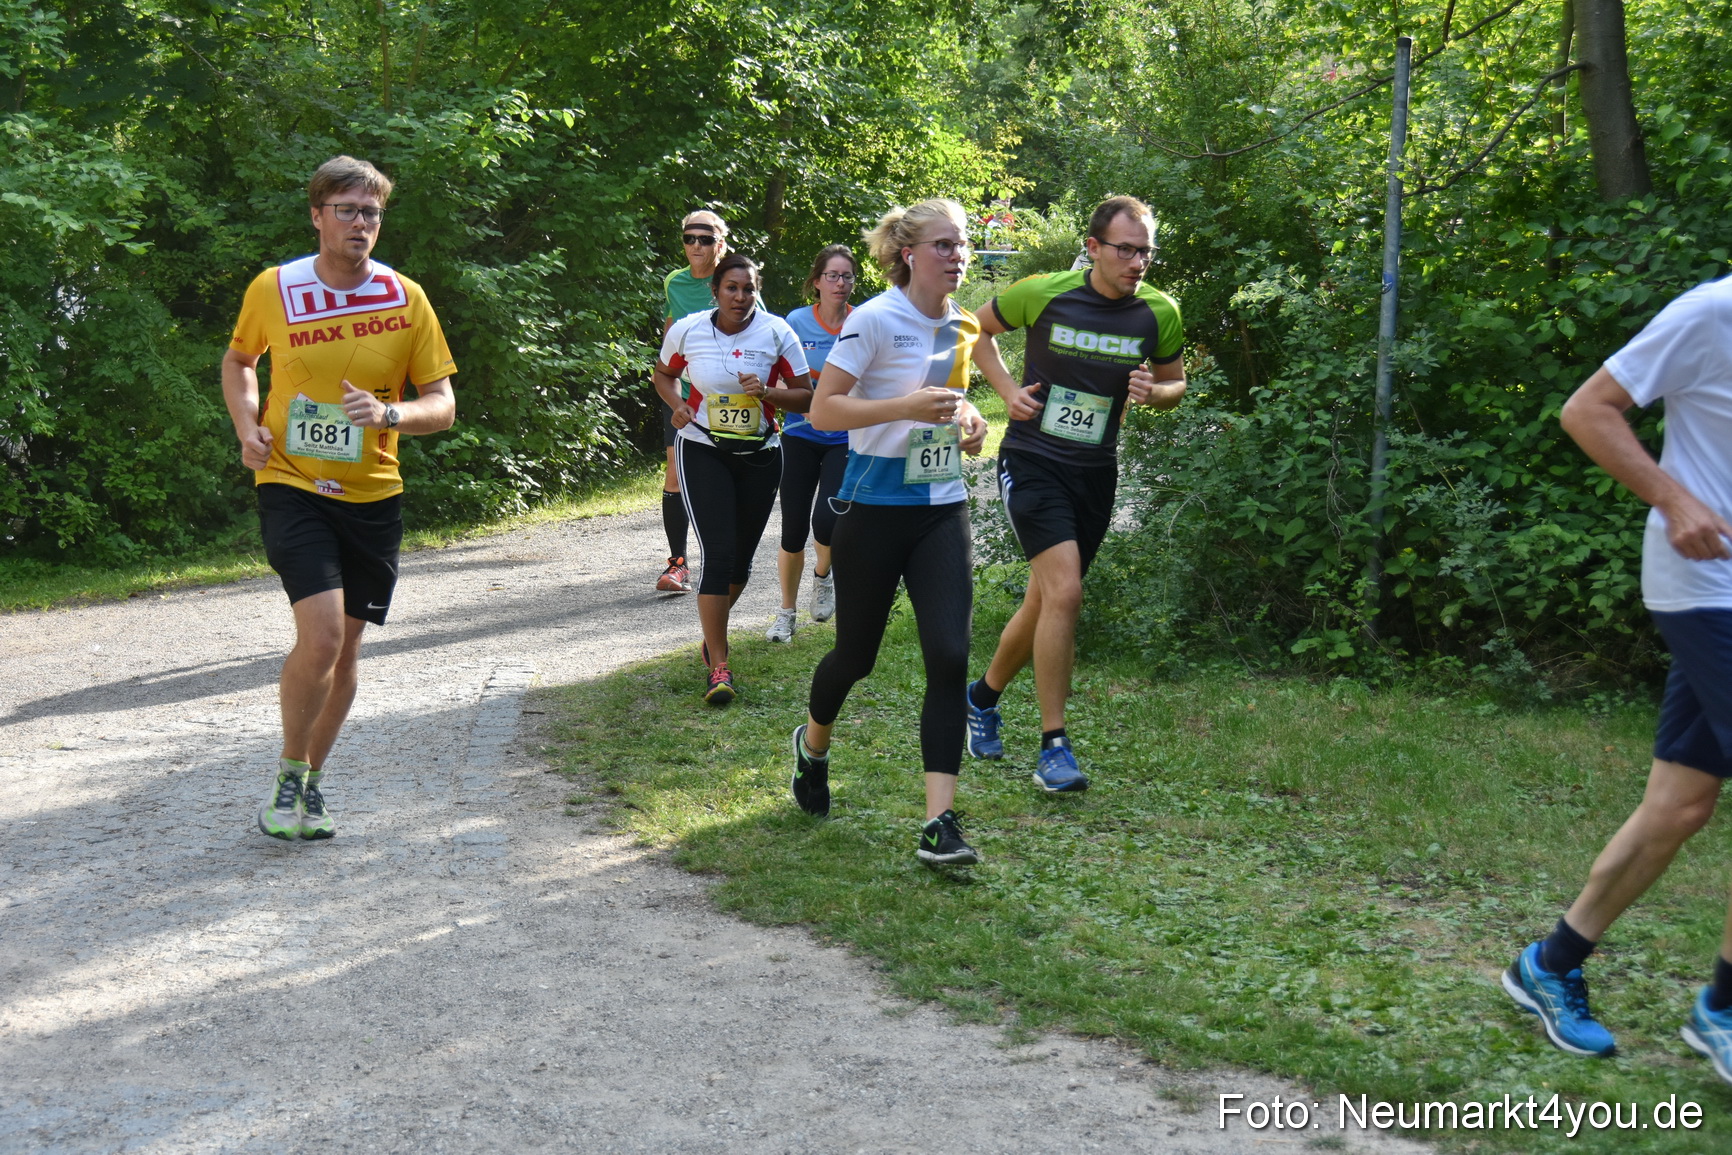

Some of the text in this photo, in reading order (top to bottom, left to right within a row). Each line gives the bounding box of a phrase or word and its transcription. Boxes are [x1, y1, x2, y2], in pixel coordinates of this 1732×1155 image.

[289, 316, 412, 348] MAX BÖGL
[1050, 323, 1145, 358] BOCK
[1048, 344, 1078, 357] inspired
[1080, 352, 1089, 360] by
[1090, 354, 1112, 363] smart
[719, 409, 750, 424] 379
[1057, 406, 1095, 429] 294
[297, 421, 350, 446] 1681
[920, 446, 951, 468] 617
